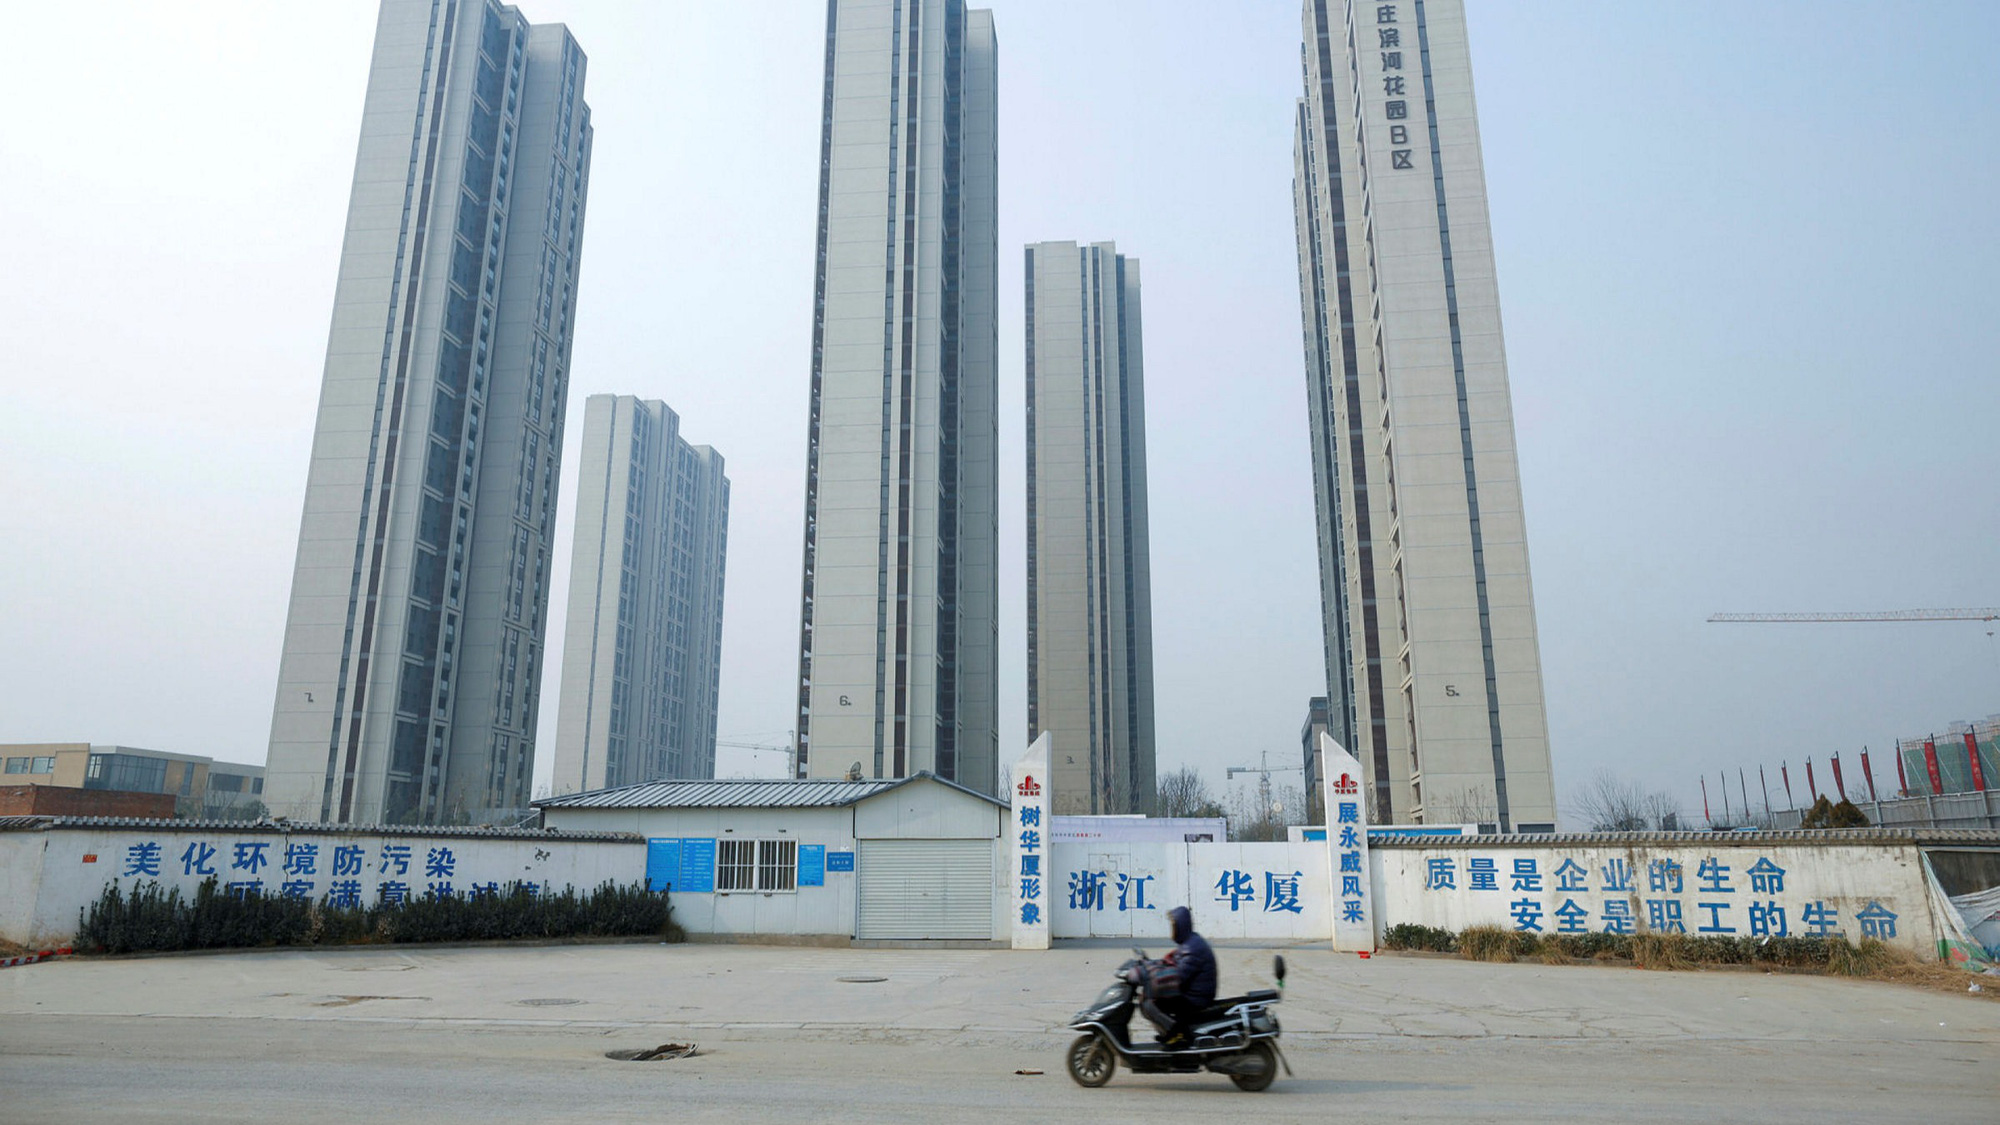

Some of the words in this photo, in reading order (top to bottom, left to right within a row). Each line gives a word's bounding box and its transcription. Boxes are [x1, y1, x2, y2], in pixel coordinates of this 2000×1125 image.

[1376, 0, 1413, 170] 庄滨河花园B区
[122, 841, 457, 878] 美化环境防污染
[1020, 805, 1041, 925] 树华厦形象
[1337, 802, 1364, 923] 展永威风采
[1426, 857, 1787, 895] 质量是企业的生命
[1068, 869, 1156, 912] 浙江
[1214, 869, 1304, 914] 华厦
[1510, 898, 1899, 941] 安全是职工的生命
